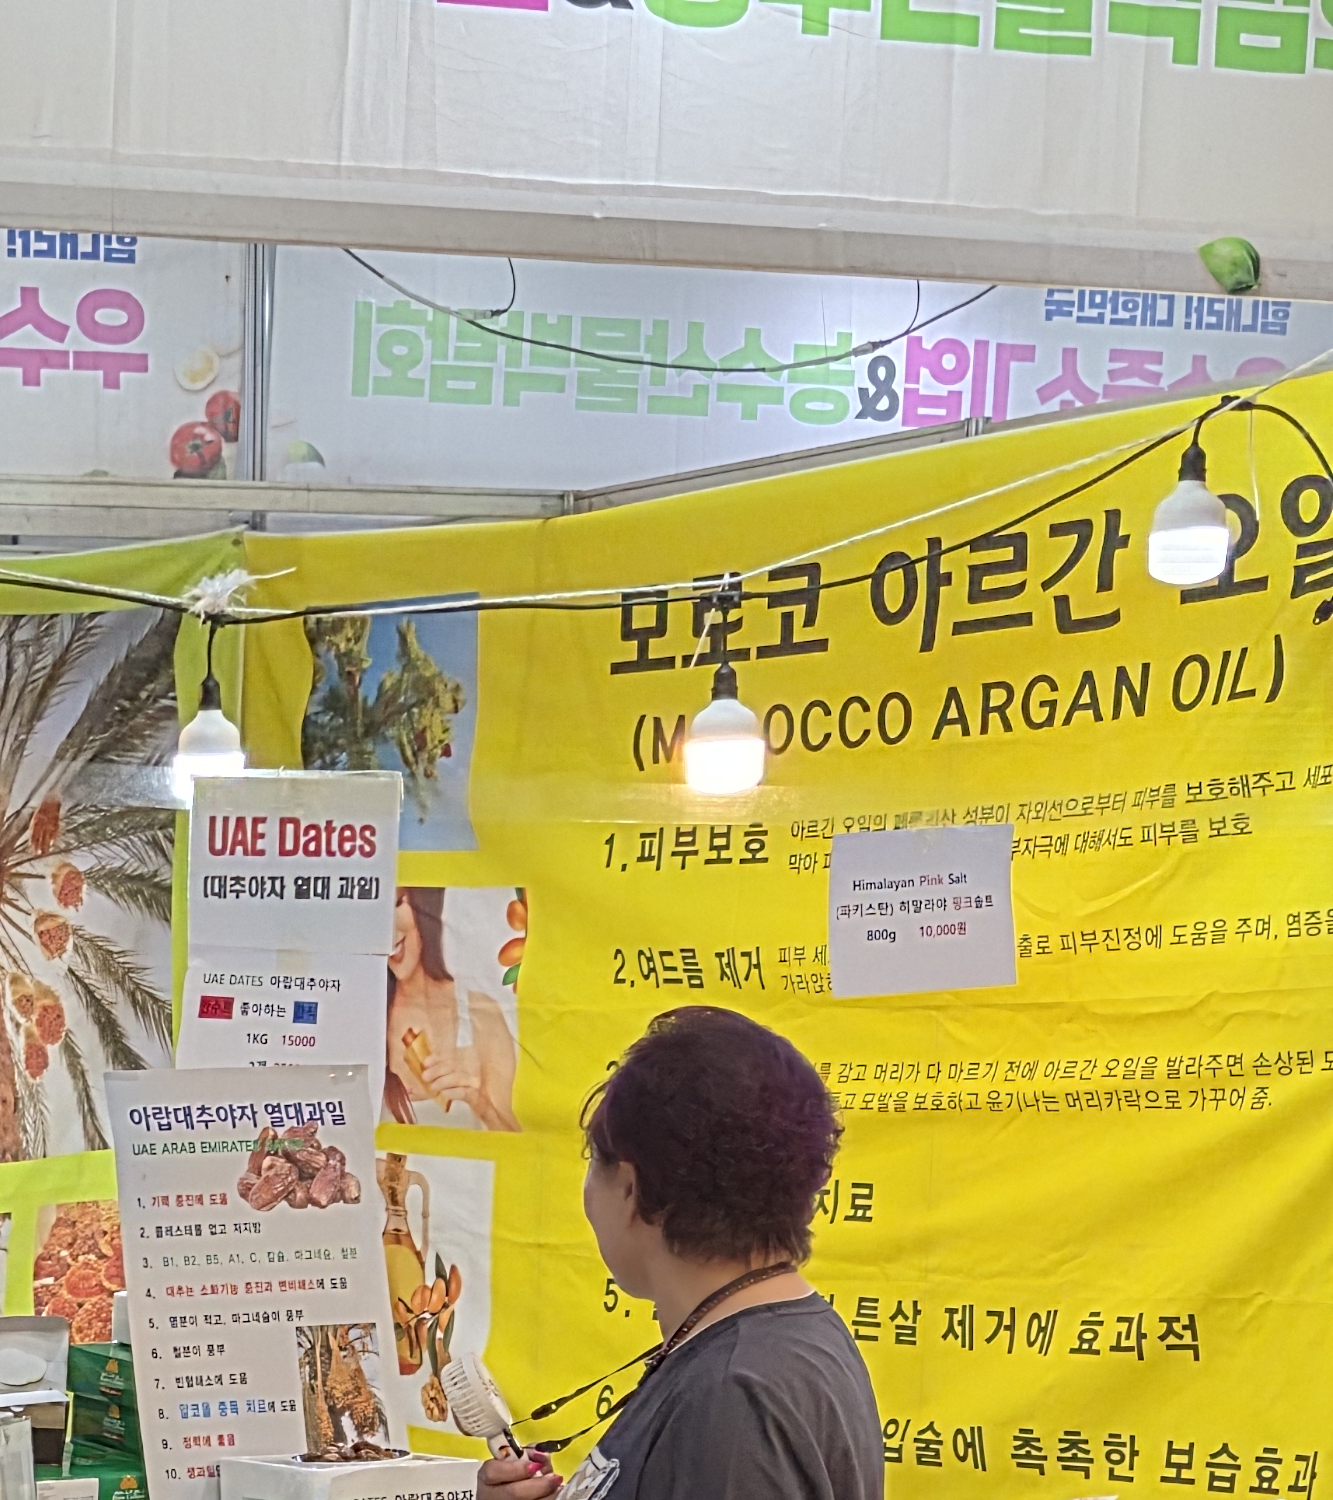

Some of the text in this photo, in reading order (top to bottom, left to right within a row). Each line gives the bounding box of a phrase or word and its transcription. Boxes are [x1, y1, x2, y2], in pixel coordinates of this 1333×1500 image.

[870, 509, 1131, 653] 아르간
[633, 634, 1286, 772] (MOCCO ARGAN OIL)
[1131, 782, 1178, 811] 피부를
[1185, 770, 1297, 804] 보호해주고
[208, 815, 377, 858] UAE Dates
[788, 811, 1253, 876] 막아 대해서도 피부를 보호
[203, 875, 380, 900] (대추야자 열대 과일)
[852, 872, 968, 893] Himalayan Pink Salt
[899, 897, 948, 914] 히말라야
[866, 920, 968, 943] 800g 10,000원
[1059, 924, 1163, 956] 피부진정에
[1169, 918, 1229, 948] 도움을
[203, 972, 341, 992] UAE DATES 아랍대추야자
[714, 945, 766, 991] 제거
[778, 946, 808, 968] 피부
[246, 1033, 317, 1048] 1KG 15000
[837, 1050, 1315, 1084] 감고 머리가 다 마르기 전에 아르간 오일을 발라주면 손상된
[129, 1100, 346, 1132] 아랍대추야자 열대과일
[859, 1091, 909, 1112] 모발을
[914, 1090, 983, 1112] 보호하고
[986, 1090, 1060, 1112] 윤기나는
[1065, 1088, 1183, 1112] 머리카락으로
[1188, 1086, 1247, 1111] 가꾸어
[132, 1140, 196, 1155] UAE ARAB
[850, 1296, 922, 1346] 튼살
[941, 1303, 1059, 1357] 제거에
[1068, 1310, 1201, 1362] 효과적
[1010, 1427, 1140, 1483] 촉촉한
